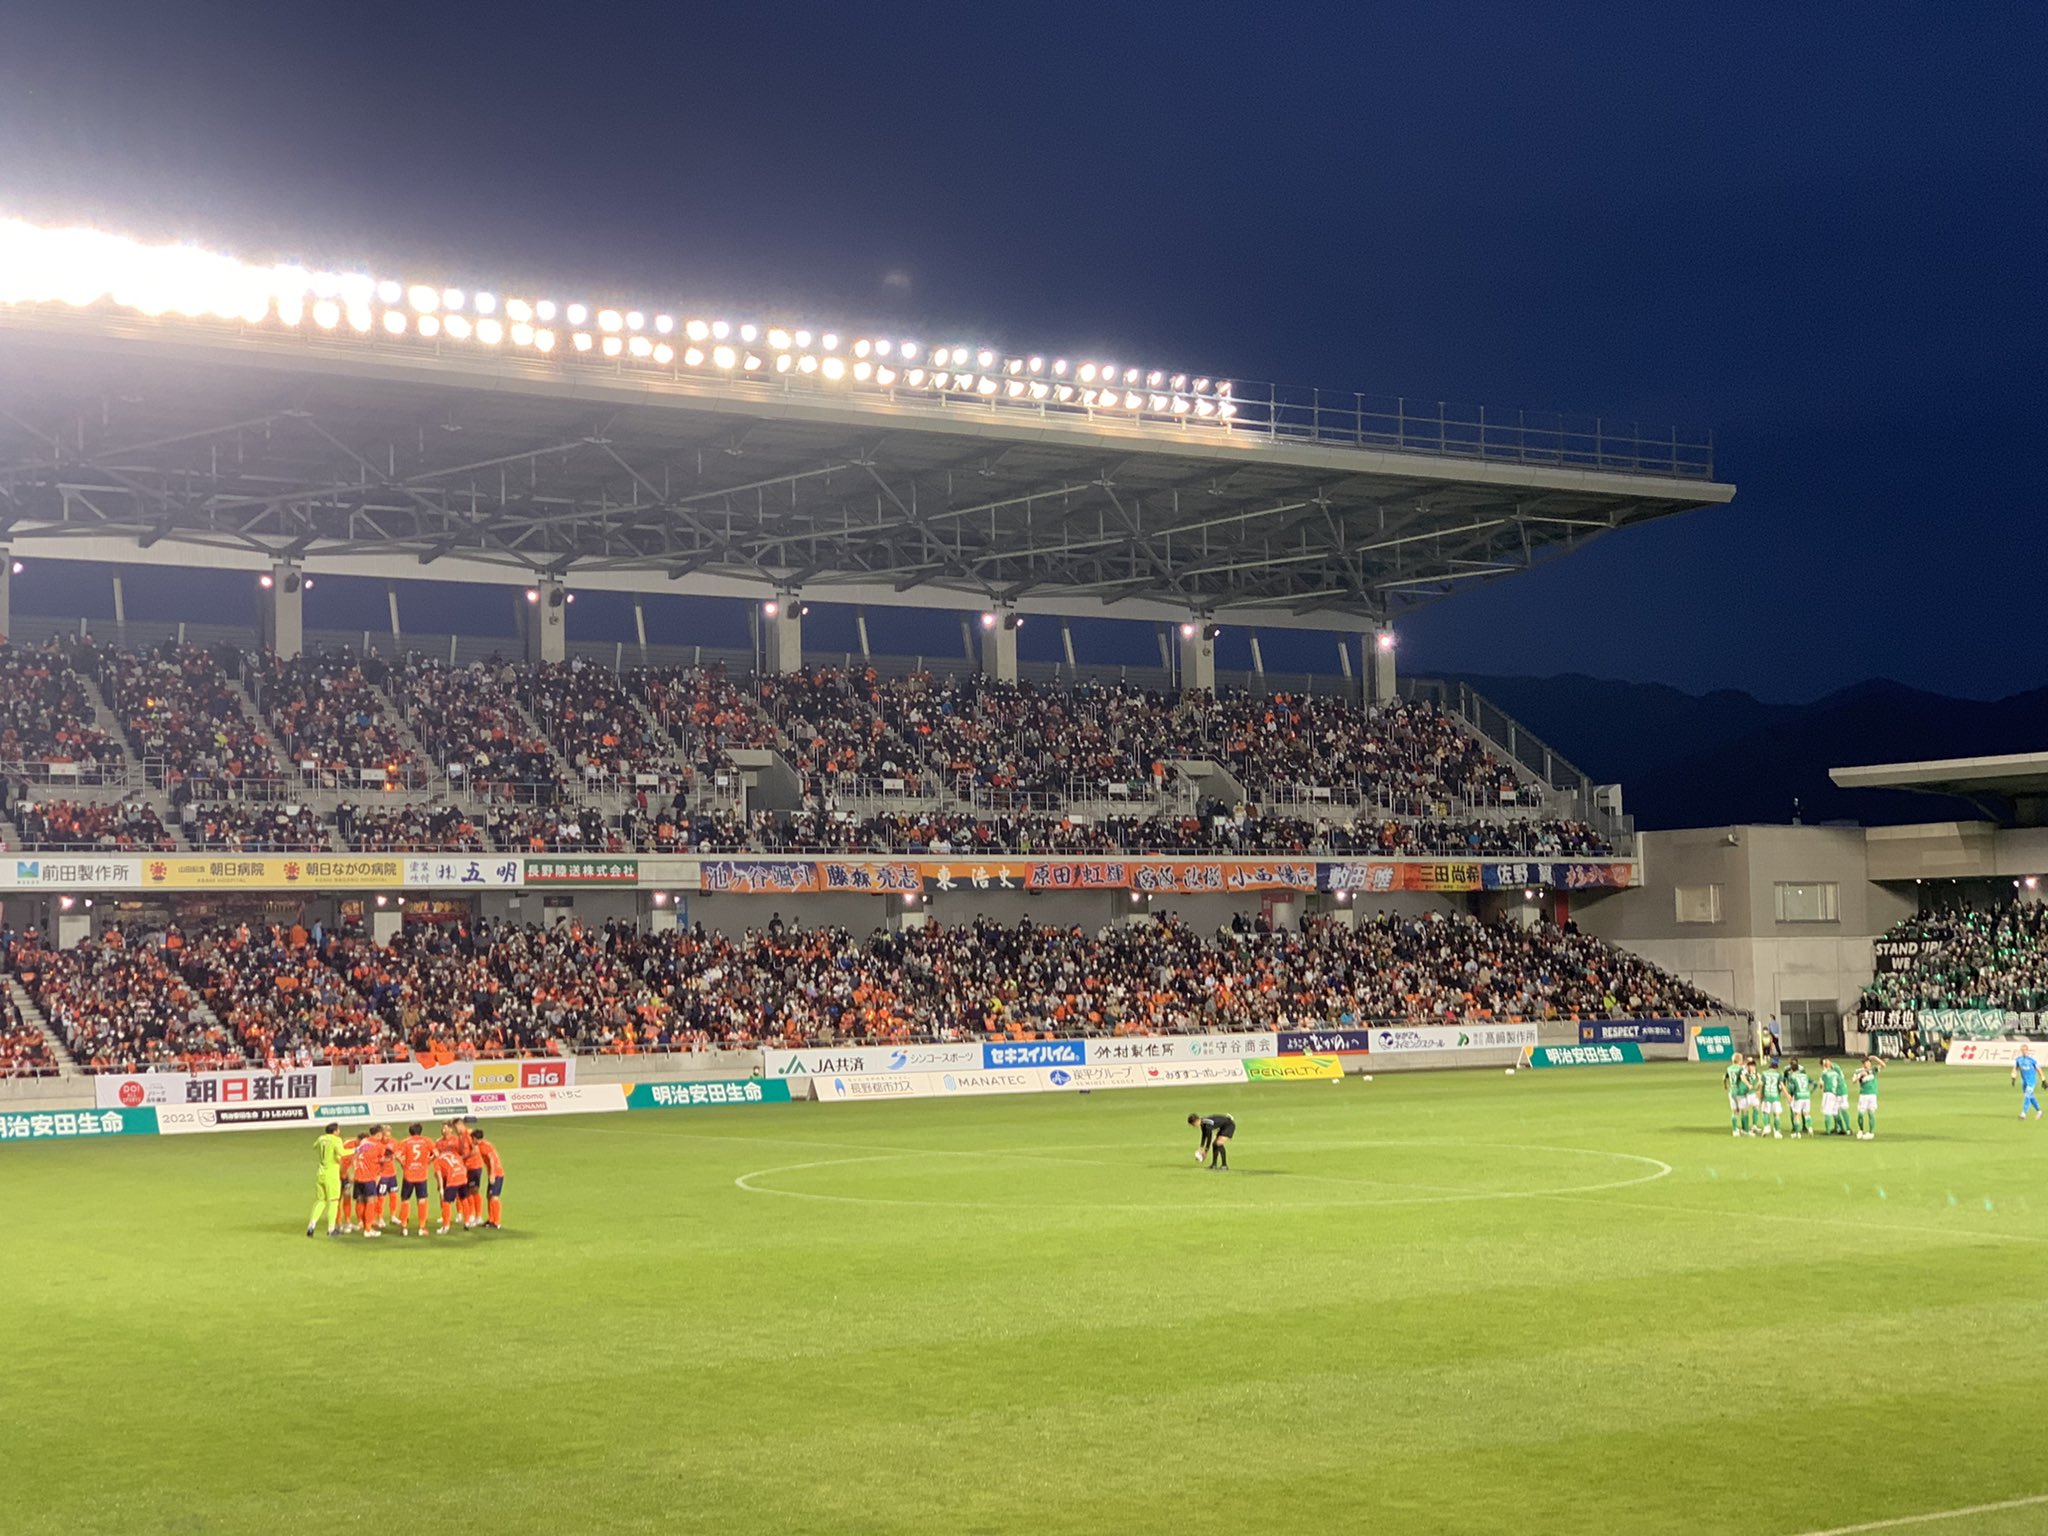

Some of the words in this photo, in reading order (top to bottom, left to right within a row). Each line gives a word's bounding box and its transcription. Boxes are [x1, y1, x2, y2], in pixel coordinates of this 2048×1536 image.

[42, 864, 129, 881] 前田製作所
[210, 862, 265, 876] 朝日病院
[306, 862, 397, 876] 朝日ながの病院
[528, 864, 635, 878] 長野陸送株式会社
[1420, 865, 1479, 883] 三田尚希
[1497, 864, 1529, 885] 佐野
[1876, 942, 1918, 956] STAND
[1891, 957, 1911, 970] WE
[1602, 1026, 1640, 1038] RESPECT
[1215, 1038, 1271, 1054] 守谷商会
[1697, 1036, 1731, 1044] 明治安田
[911, 1052, 974, 1064] シンコースポーツ
[991, 1046, 1075, 1065] セキスイハイム
[1545, 1046, 1624, 1064] 明治安田生命
[811, 1057, 865, 1074] JA共済
[1250, 1066, 1320, 1078] PENALTY
[374, 1072, 471, 1093] スポーツくじ
[851, 1080, 914, 1093] 長野都市ガス
[959, 1075, 1026, 1087] MANATEC
[186, 1075, 317, 1103] 朝日新聞
[652, 1082, 762, 1105] 明治安田生命
[271, 1109, 304, 1118] LEAGUE
[387, 1103, 415, 1112] DAZN
[513, 1103, 546, 1111] KONAMI
[162, 1114, 195, 1124] 2022
[413, 1144, 421, 1160] 5
